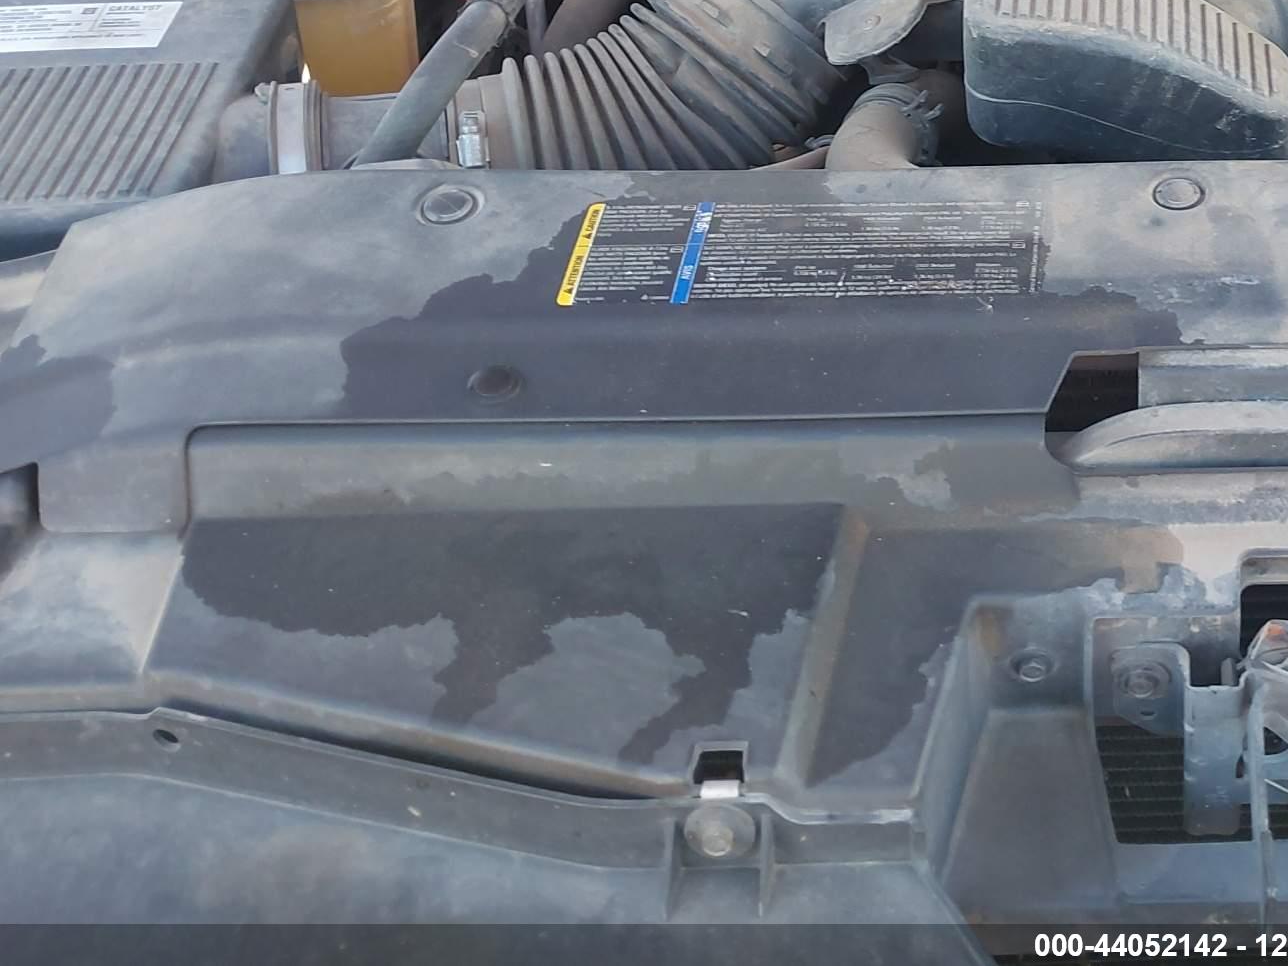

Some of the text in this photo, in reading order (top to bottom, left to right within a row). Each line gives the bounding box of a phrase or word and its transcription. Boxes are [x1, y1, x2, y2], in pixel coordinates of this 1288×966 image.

[108, 4, 162, 12] CATALYST
[585, 209, 600, 232] CAUTION
[567, 255, 584, 287] ATTENTION
[680, 264, 694, 280] AVIS
